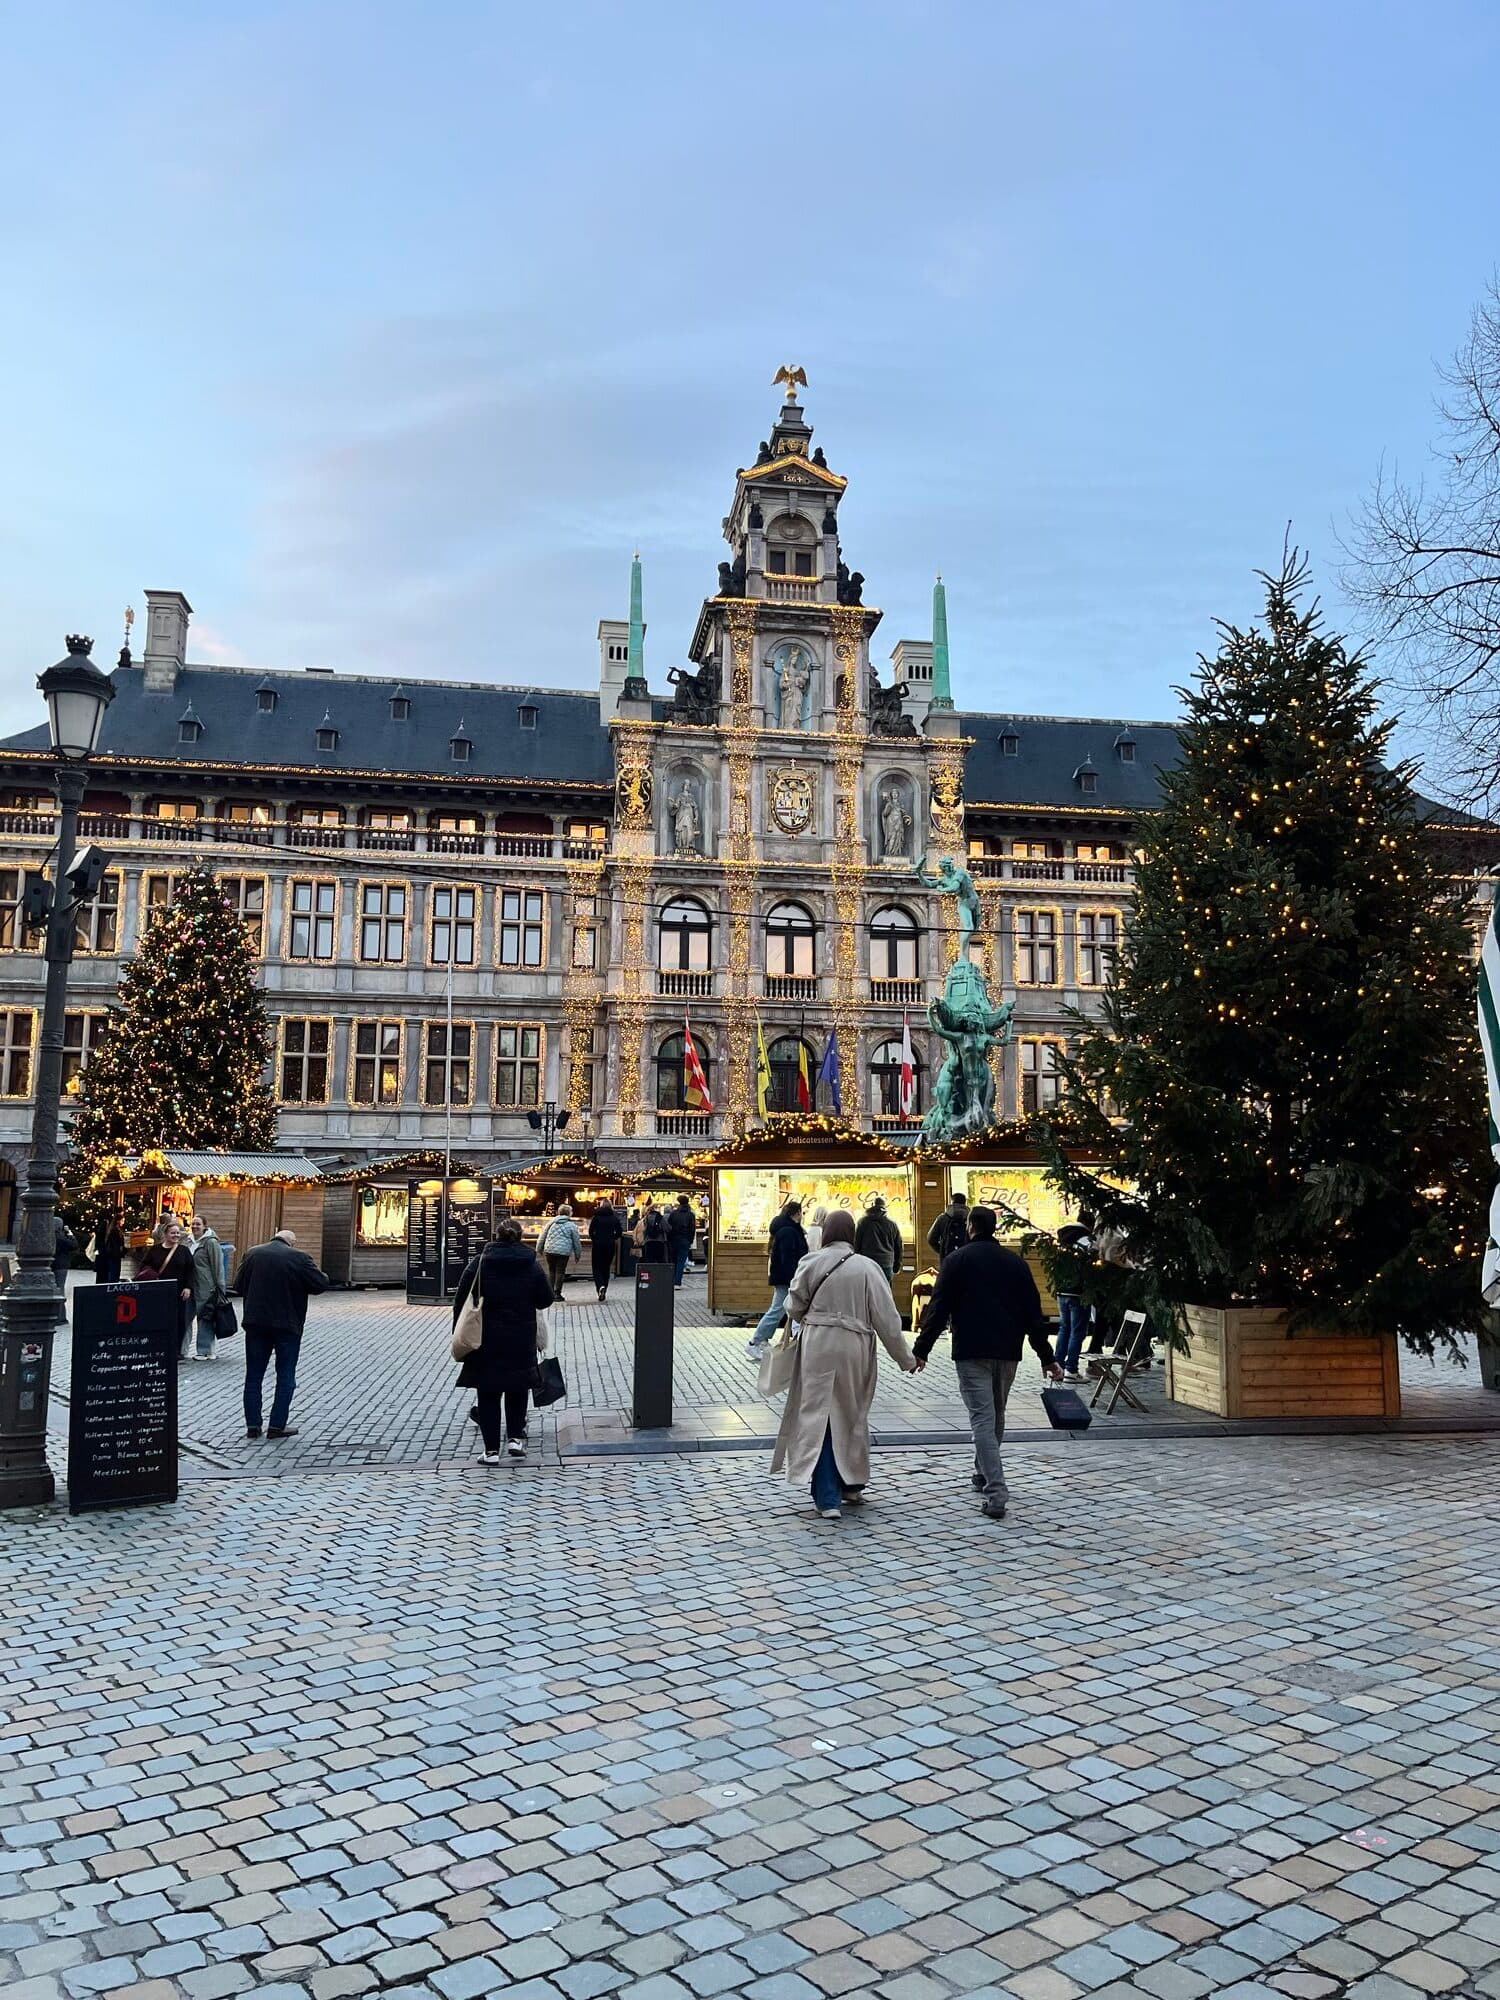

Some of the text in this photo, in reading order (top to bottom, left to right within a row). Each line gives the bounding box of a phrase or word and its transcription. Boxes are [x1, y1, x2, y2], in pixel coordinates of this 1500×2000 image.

[787, 1136, 834, 1144] Delicatessen
[116, 1295, 137, 1325] D
[106, 1337, 140, 1346] GEBAK
